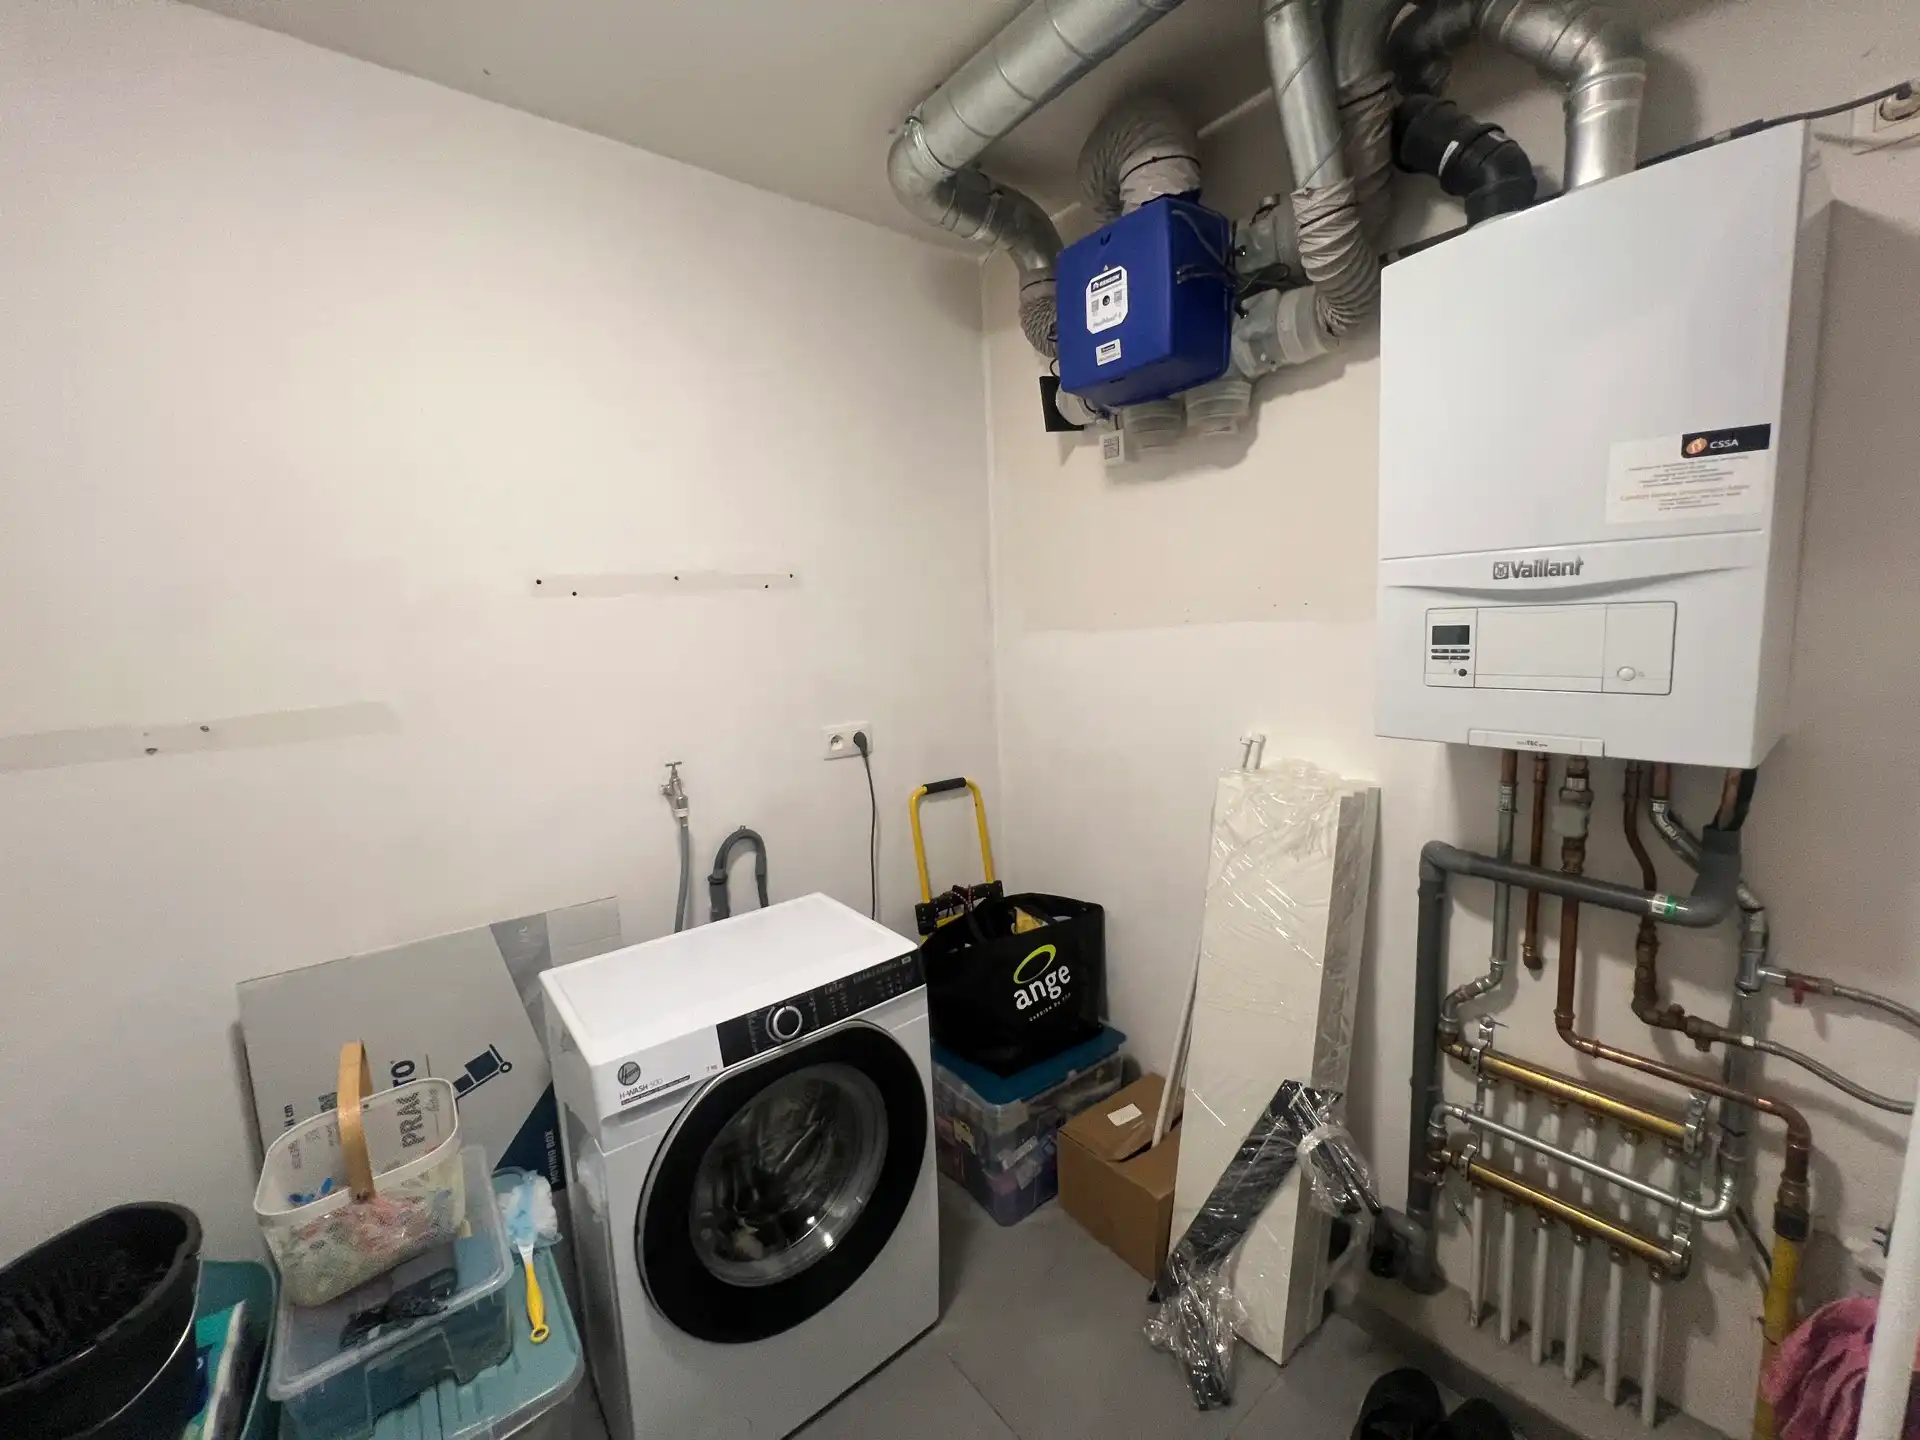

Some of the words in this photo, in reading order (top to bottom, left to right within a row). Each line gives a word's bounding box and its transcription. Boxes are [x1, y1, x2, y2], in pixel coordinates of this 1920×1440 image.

[1709, 438, 1740, 450] CSSA
[1510, 556, 1584, 579] Vaillant
[1013, 965, 1071, 1010] ange
